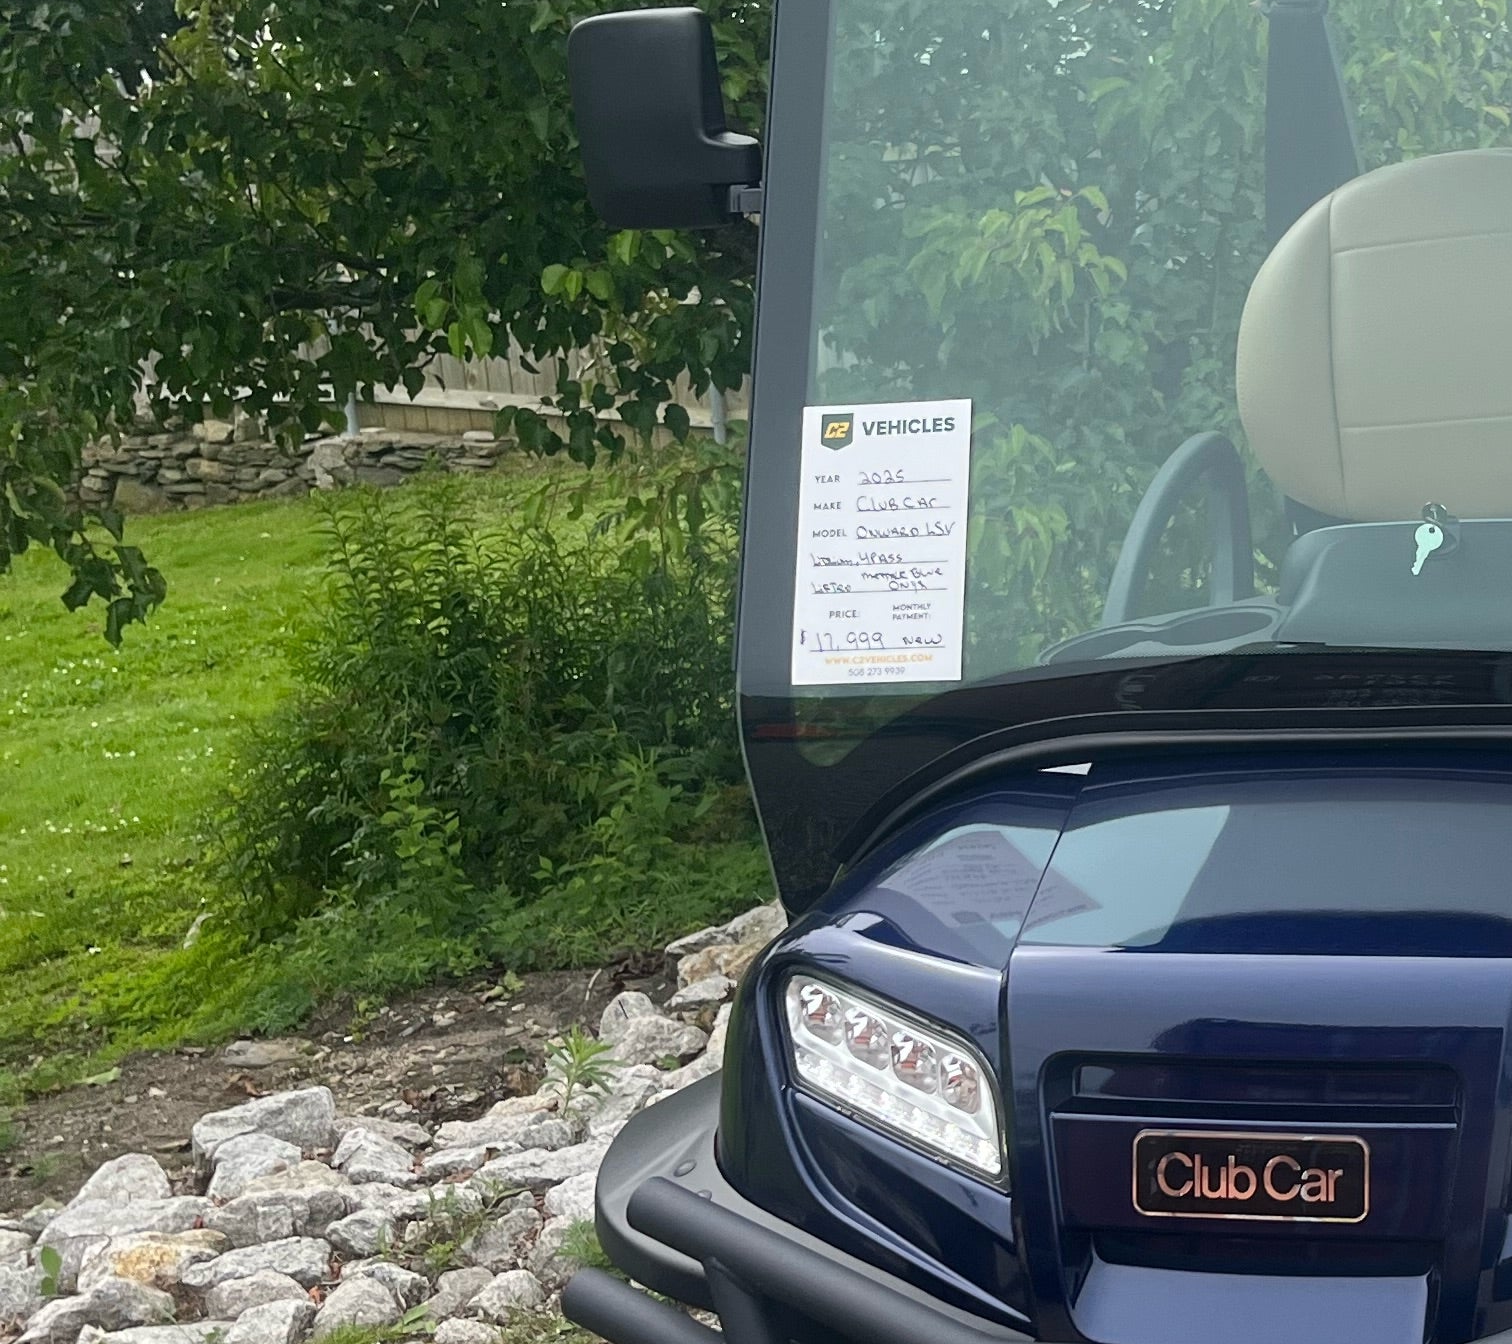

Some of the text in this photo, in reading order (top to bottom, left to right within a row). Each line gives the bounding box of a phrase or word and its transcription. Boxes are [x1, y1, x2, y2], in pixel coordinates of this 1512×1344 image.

[862, 417, 956, 436] VEHICLES
[815, 474, 841, 484] YEAR
[858, 469, 905, 485] 2025
[813, 501, 842, 510] MAKE
[813, 529, 848, 538] MODEL
[893, 602, 931, 612] MONTHLY
[892, 612, 931, 621] PAYMENT:
[825, 654, 933, 665] WWW.C2VEHICLES.COM
[867, 667, 882, 676] 273
[1156, 1151, 1344, 1203] Club Car
